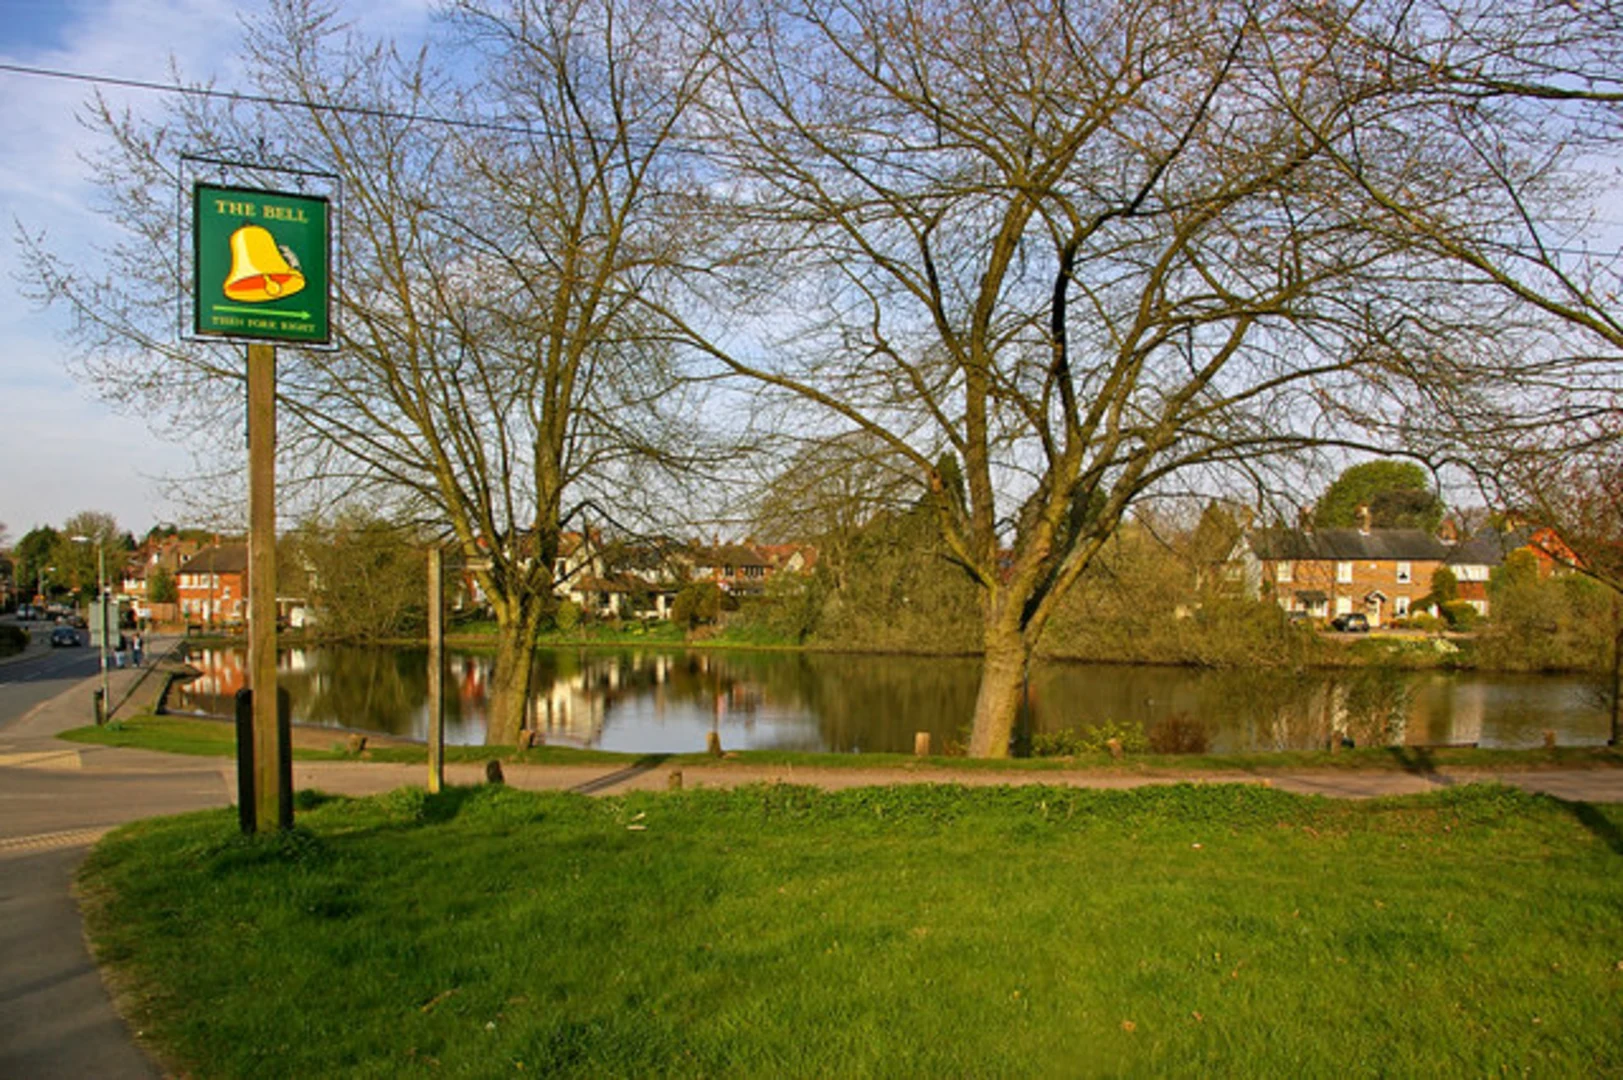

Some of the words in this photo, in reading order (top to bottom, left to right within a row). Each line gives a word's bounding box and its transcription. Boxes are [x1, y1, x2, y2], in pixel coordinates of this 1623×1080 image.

[215, 199, 256, 217] THE
[263, 206, 309, 223] BELL
[212, 316, 244, 326] THEN
[247, 319, 276, 329] FORK
[280, 322, 316, 333] RIGHT
